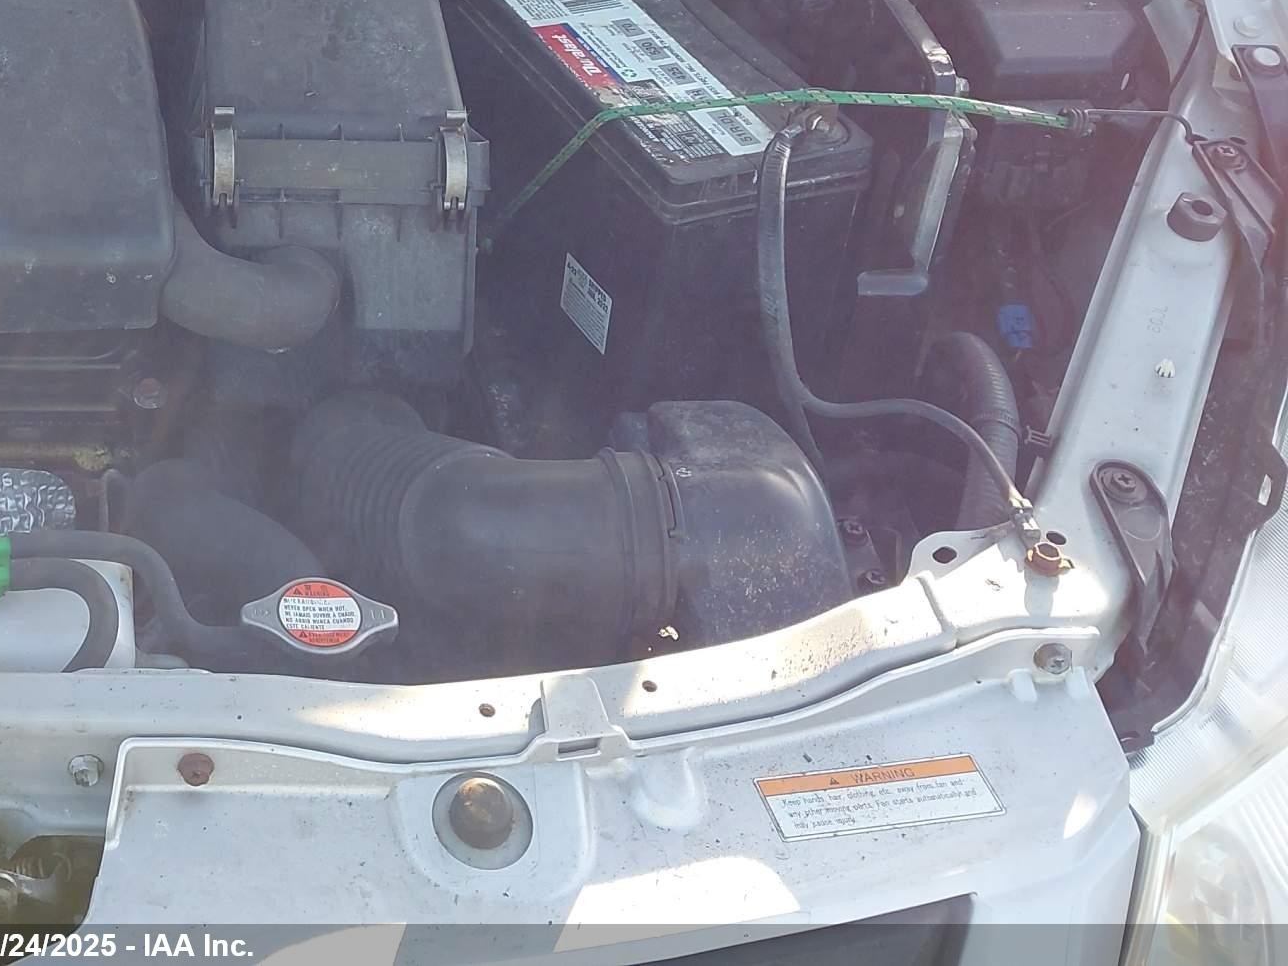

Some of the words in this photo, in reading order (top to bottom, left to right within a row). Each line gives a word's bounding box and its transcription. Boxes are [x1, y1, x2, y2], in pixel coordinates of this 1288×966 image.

[551, 33, 602, 76] Duralast
[718, 114, 753, 143] 51R-DL
[850, 767, 915, 784] WARNING
